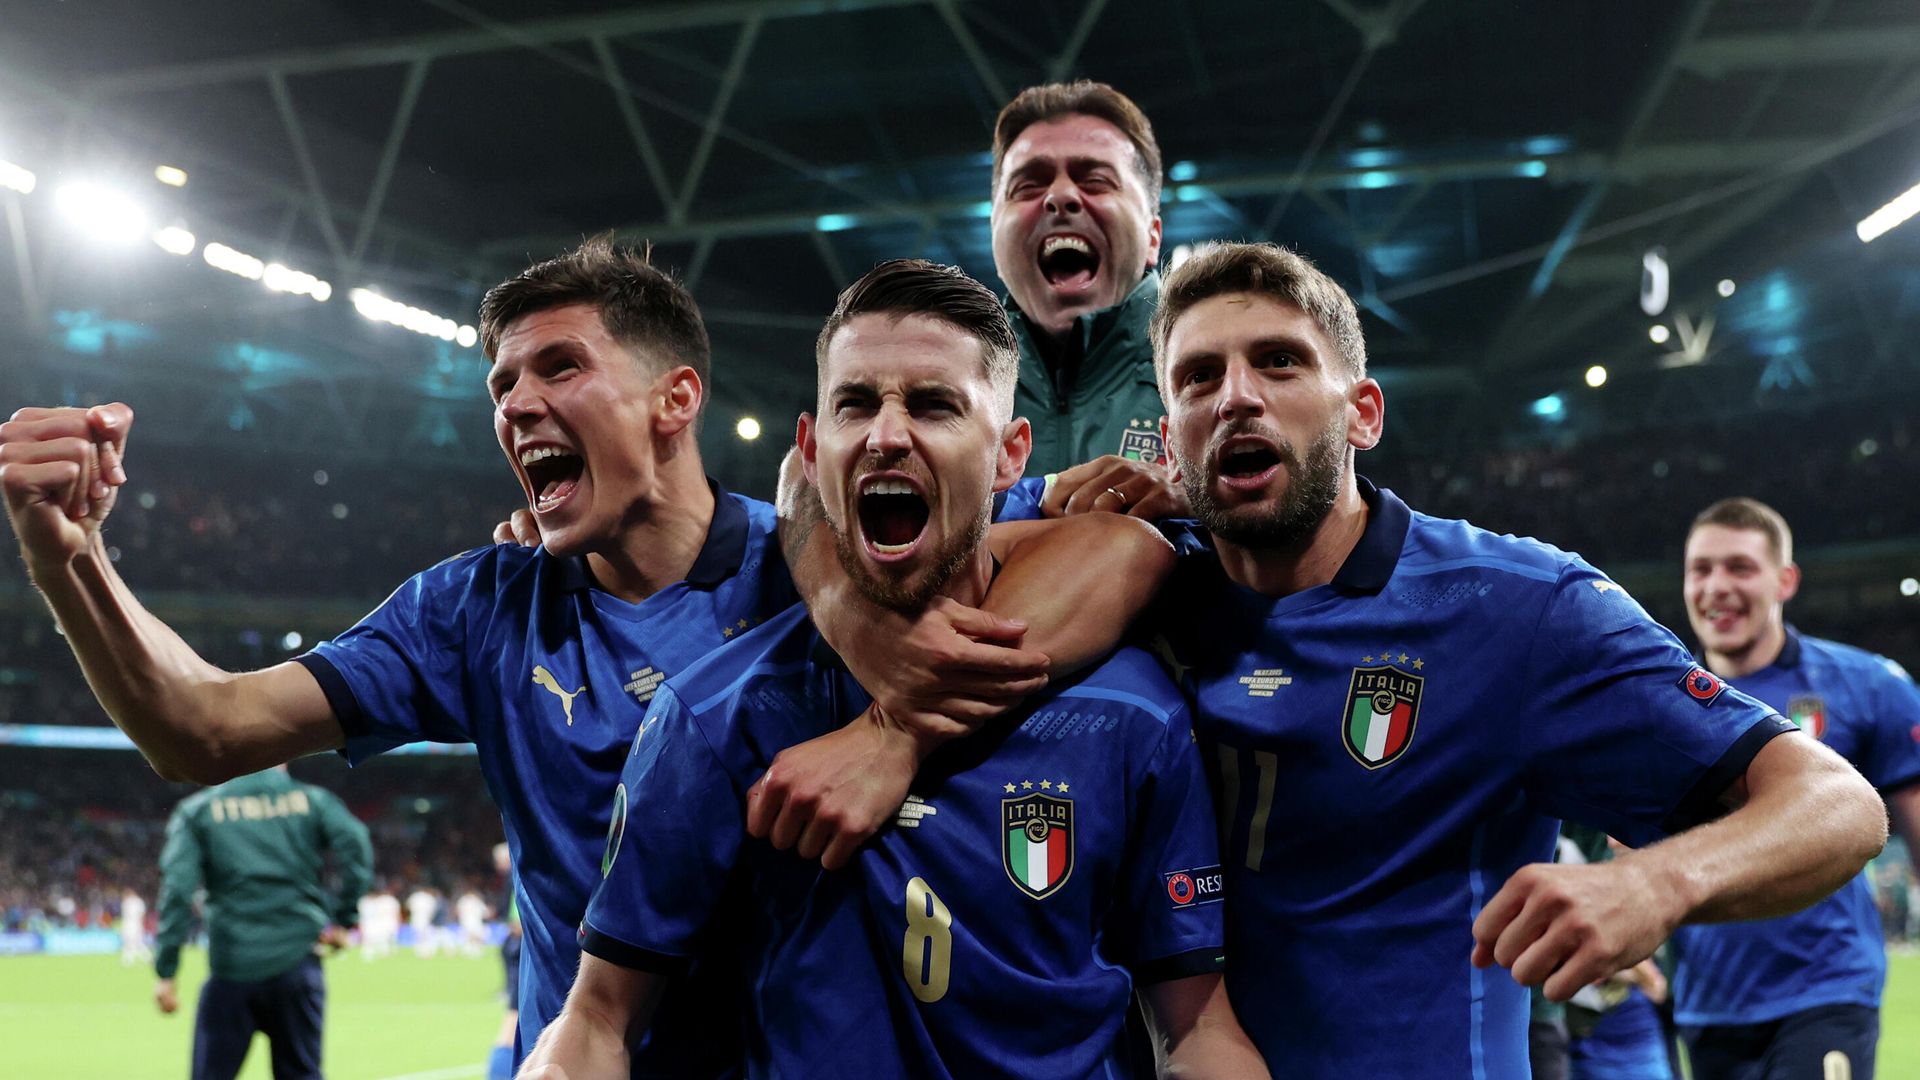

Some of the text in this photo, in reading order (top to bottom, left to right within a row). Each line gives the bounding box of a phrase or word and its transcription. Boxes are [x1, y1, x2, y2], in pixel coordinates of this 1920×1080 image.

[1128, 435, 1163, 450] ITAL
[1358, 674, 1416, 696] ITALIA
[211, 790, 309, 823] ITALIA
[1009, 803, 1066, 820] ITALIA
[1171, 874, 1223, 894] UEFA RES
[903, 876, 952, 1003] 8
